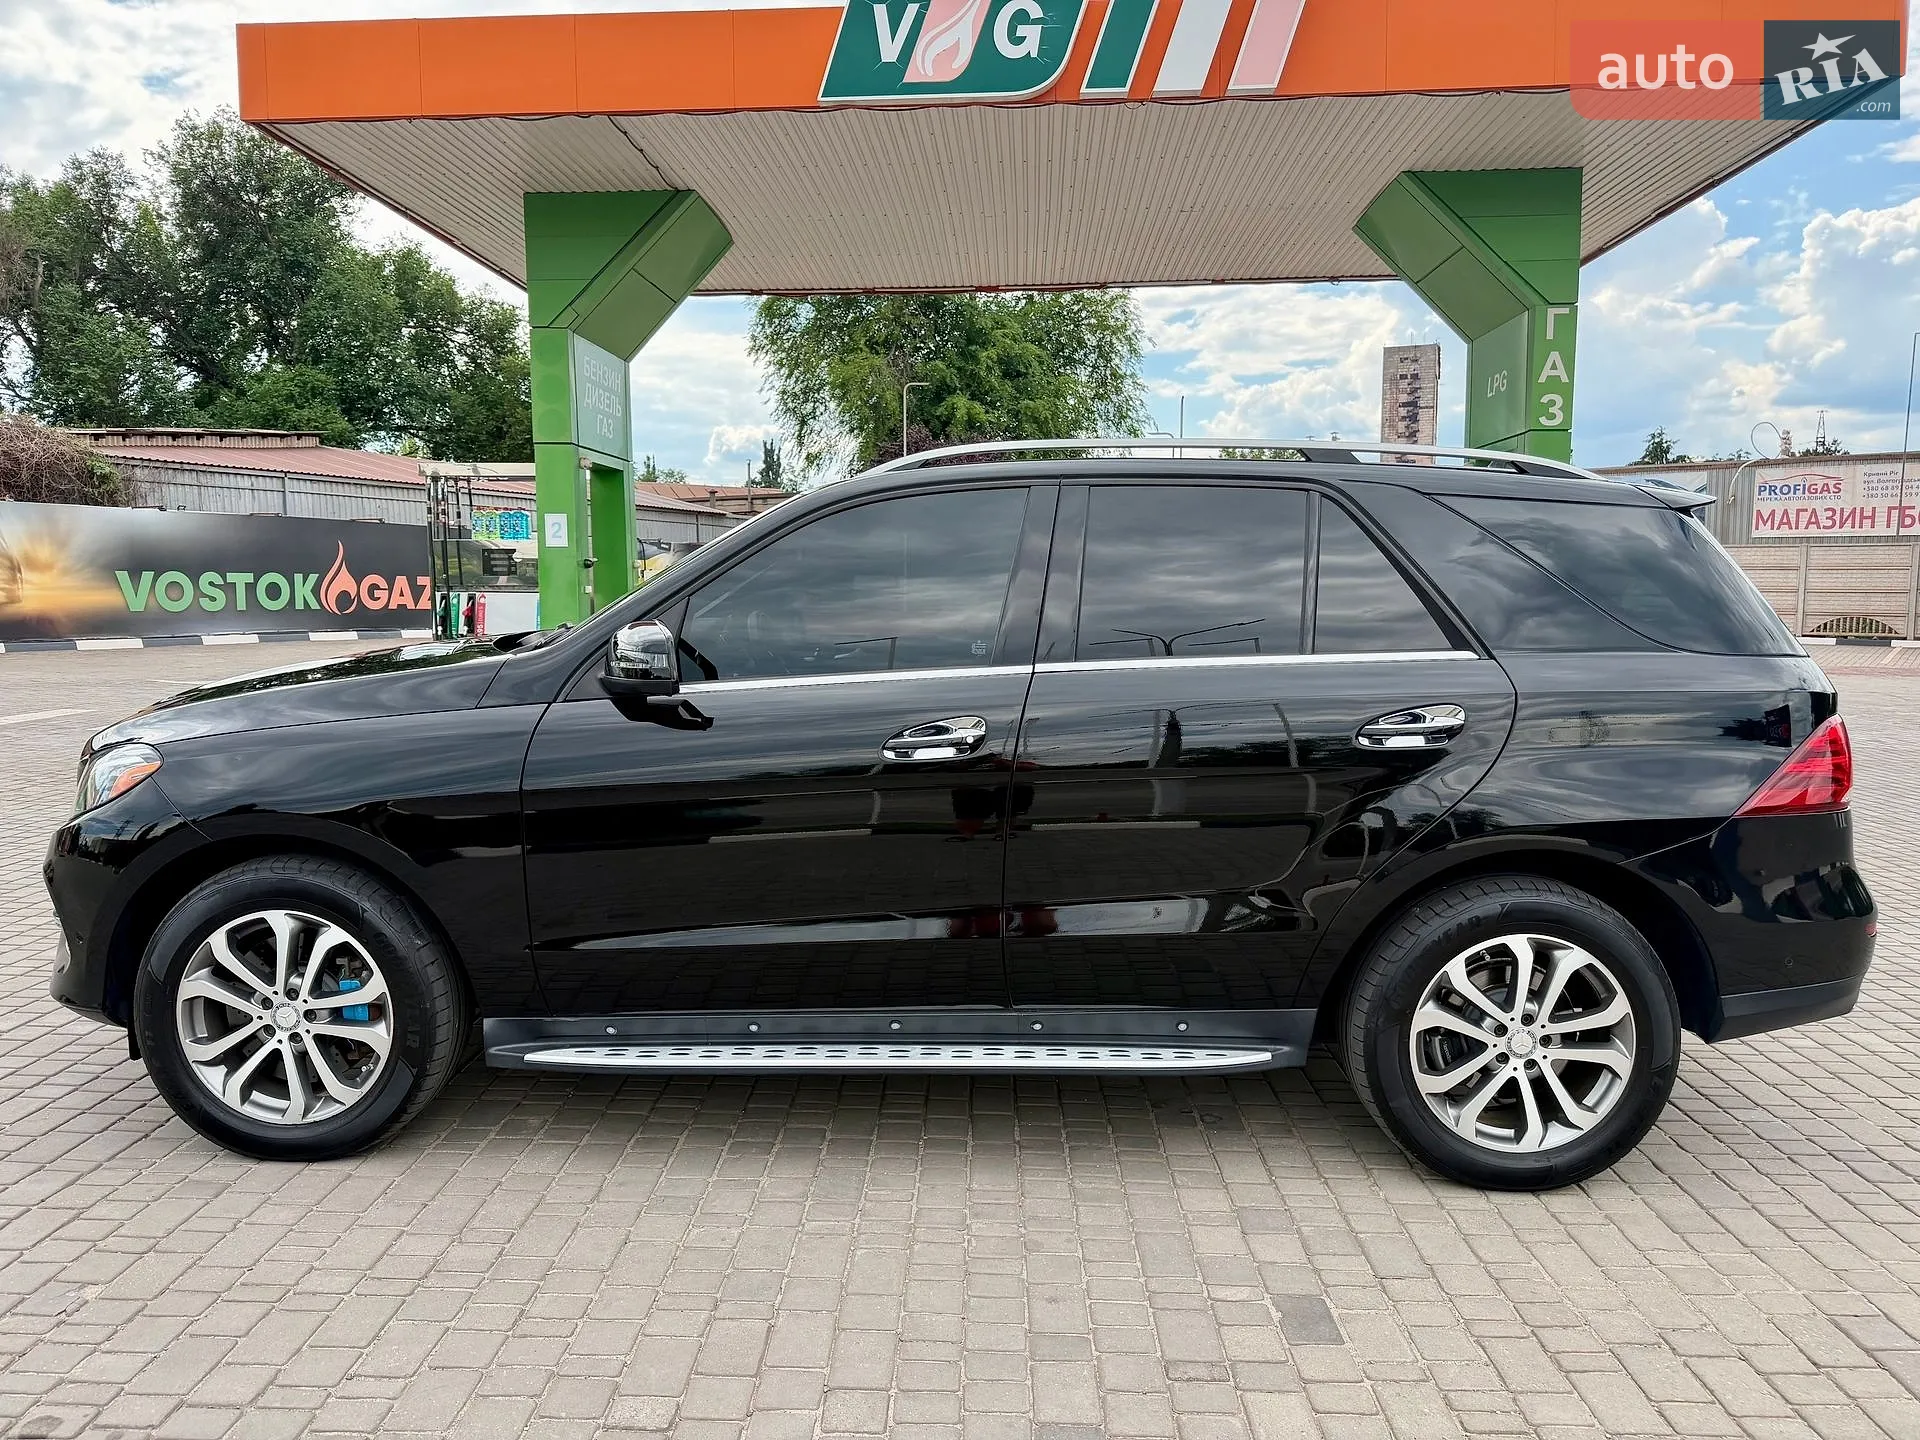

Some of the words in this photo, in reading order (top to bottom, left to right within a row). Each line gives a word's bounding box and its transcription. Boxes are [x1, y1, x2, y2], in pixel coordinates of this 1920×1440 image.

[872, 2, 916, 63] V
[993, 0, 1044, 58] G
[583, 355, 621, 393] БЕНЗИН
[1487, 369, 1508, 398] LPG
[1537, 307, 1570, 427] ГАЗ
[583, 382, 622, 417] ДИЗЕЛЬ
[596, 414, 614, 439] ГАЗ
[551, 521, 562, 539] 2
[1754, 506, 1877, 531] МАГАЗИН
[1886, 505, 1920, 528] ГБ
[115, 570, 321, 613] VOSTOK
[359, 574, 431, 610] GAZ
